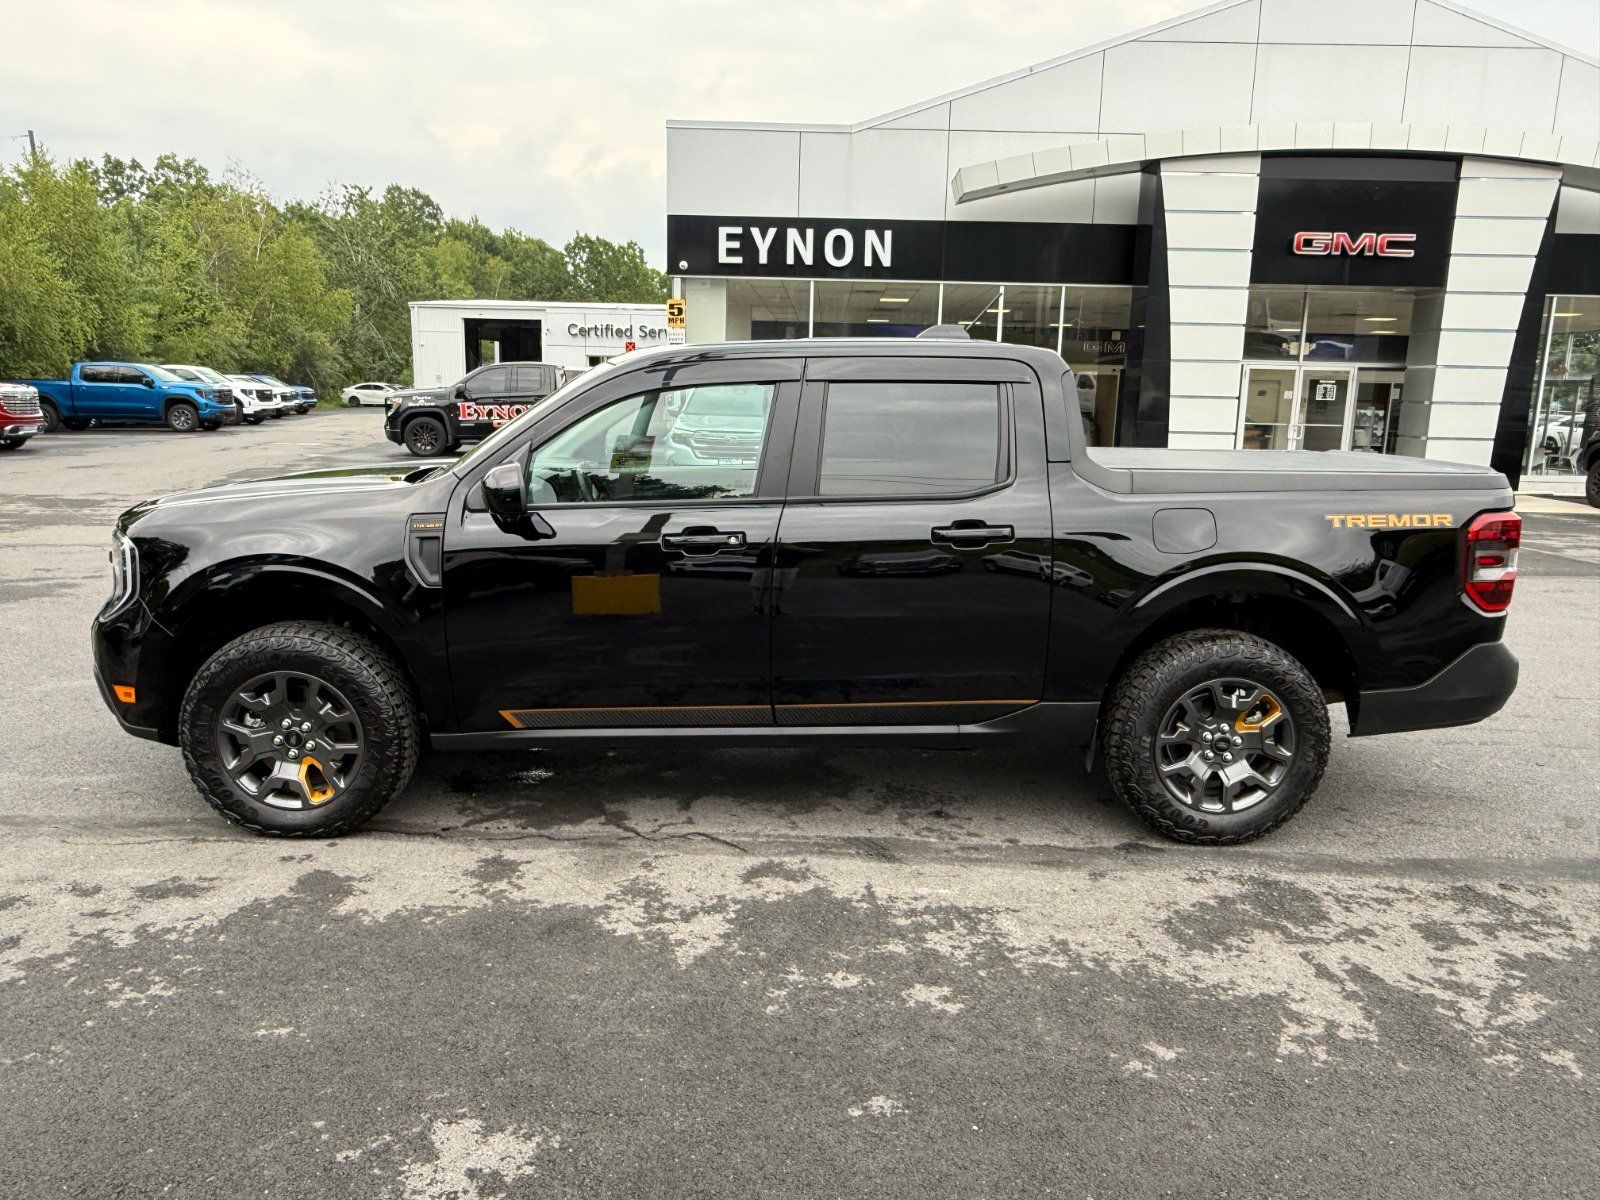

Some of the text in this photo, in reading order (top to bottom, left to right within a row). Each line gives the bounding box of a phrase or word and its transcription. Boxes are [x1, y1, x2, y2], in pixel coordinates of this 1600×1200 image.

[718, 226, 892, 268] EYNON
[1293, 231, 1417, 258] GMC
[668, 302, 684, 317] 5
[567, 323, 633, 339] Certified
[457, 401, 534, 421] EYNO
[1325, 513, 1454, 528] TREMOR
